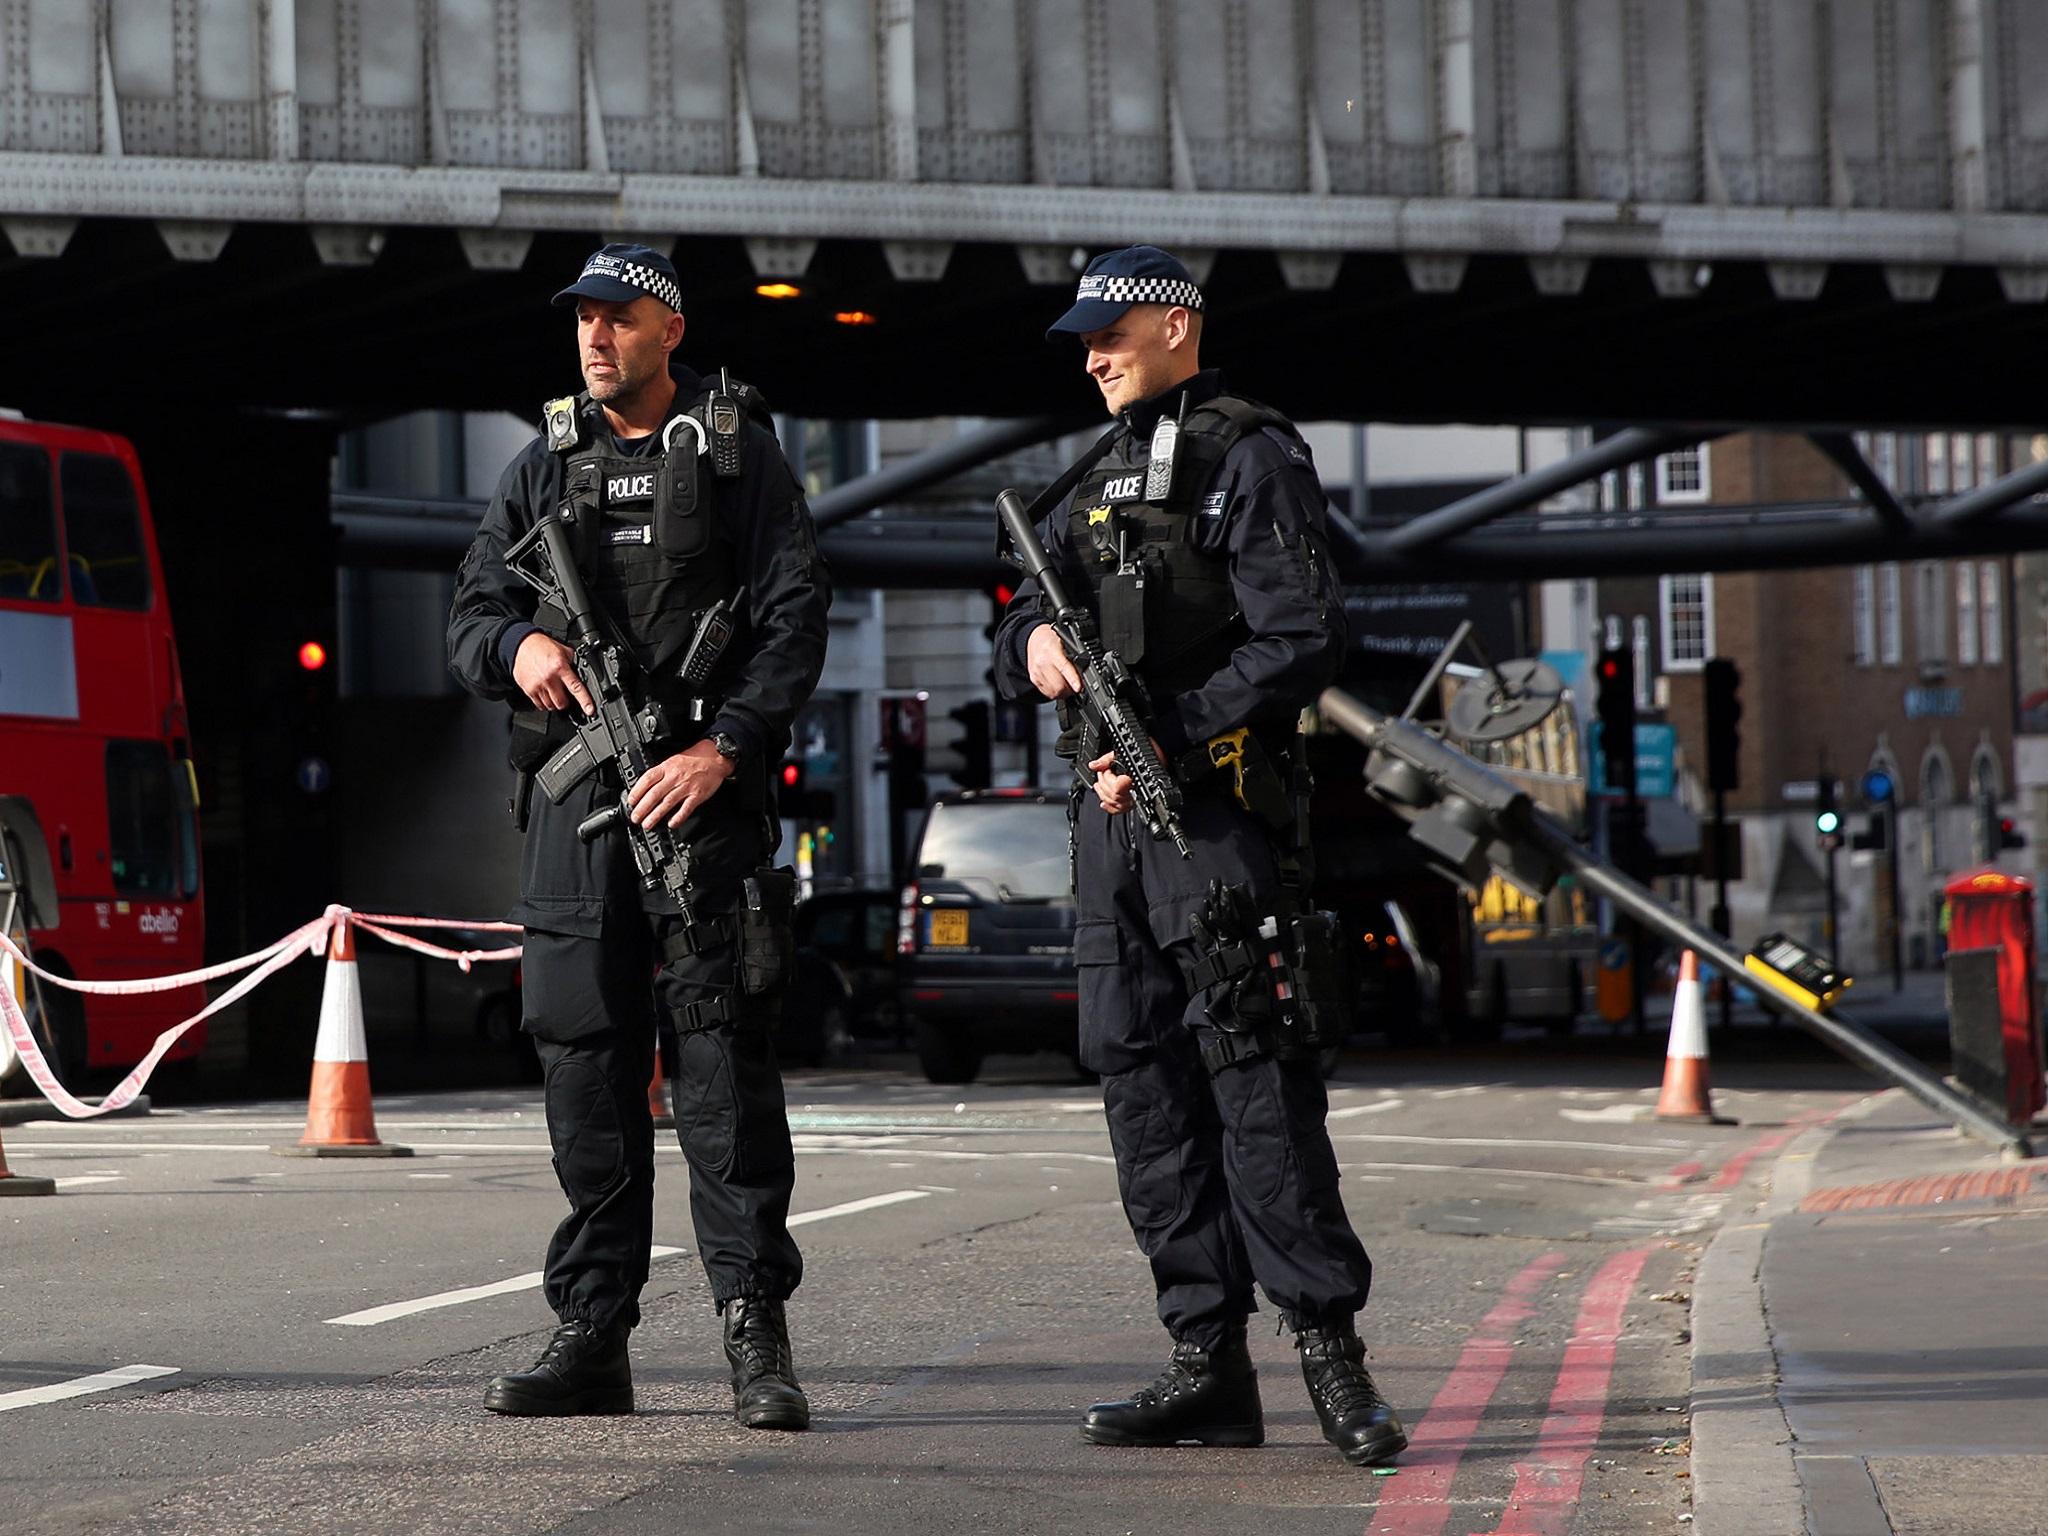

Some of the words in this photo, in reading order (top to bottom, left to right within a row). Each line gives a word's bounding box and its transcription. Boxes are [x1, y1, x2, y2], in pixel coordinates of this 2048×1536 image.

[594, 268, 620, 278] OFFICER
[608, 475, 654, 501] POLICE
[1102, 475, 1143, 501] POLICE
[1362, 635, 1411, 650] Thank
[139, 904, 178, 933] abellio
